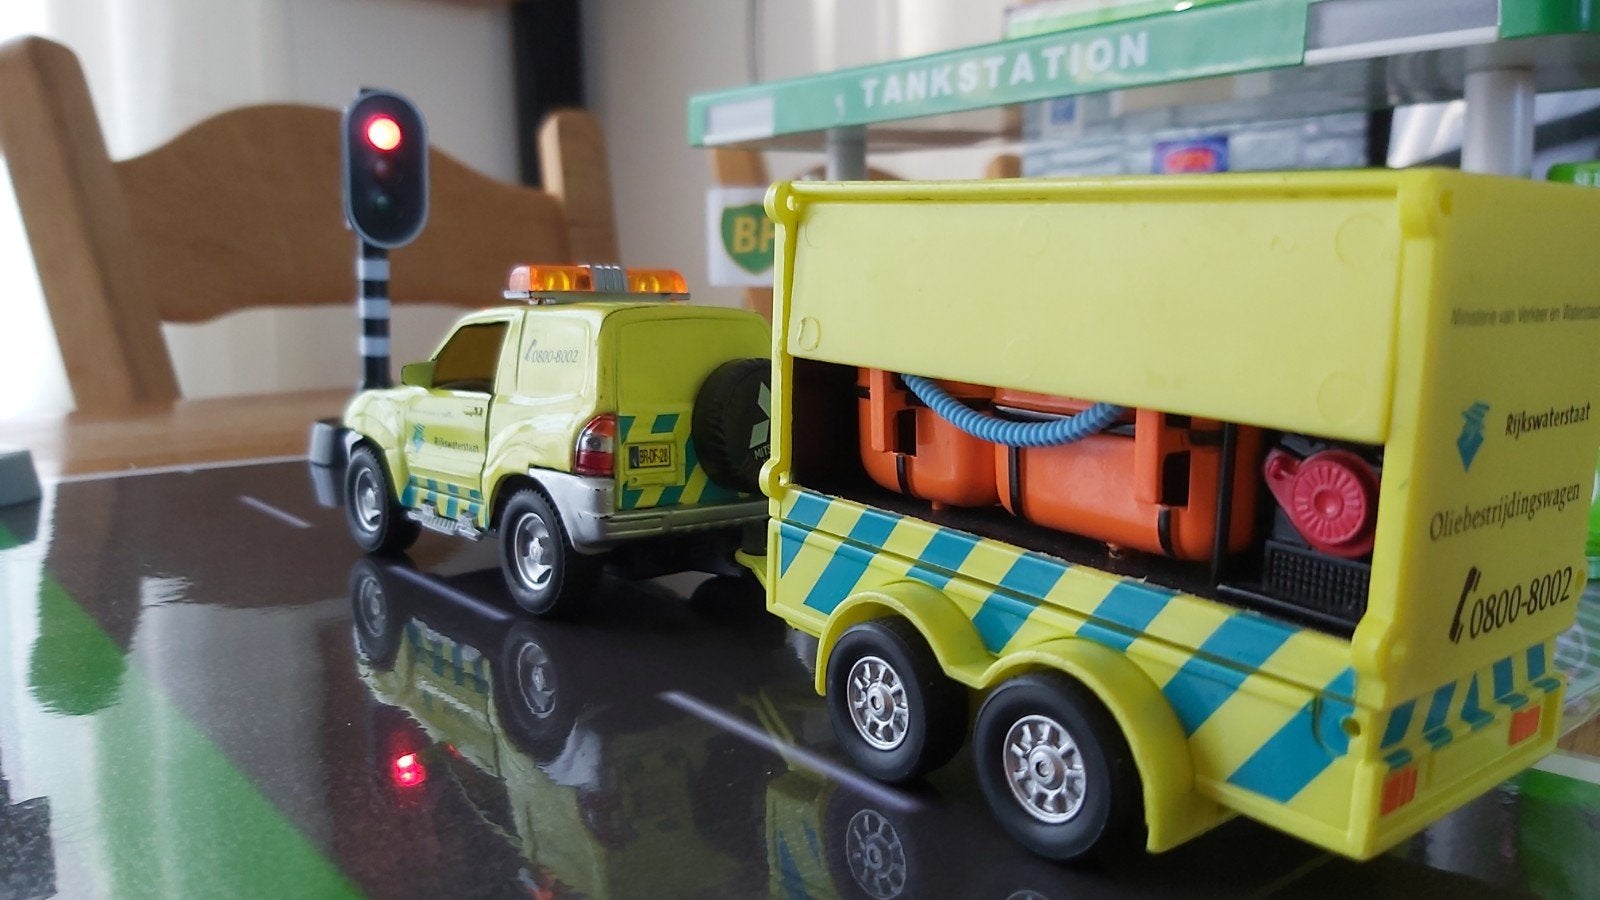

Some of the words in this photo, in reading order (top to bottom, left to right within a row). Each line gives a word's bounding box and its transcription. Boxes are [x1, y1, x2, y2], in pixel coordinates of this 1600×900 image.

[861, 31, 1148, 108] TANKSTATION
[532, 349, 579, 364] 0800-8002
[434, 435, 479, 453] Rijkswaterstaat
[1505, 401, 1591, 439] Rijkswaterstaat
[1429, 483, 1580, 542] Oliebestrijdingswagen
[1469, 566, 1573, 639] 0800-8002
